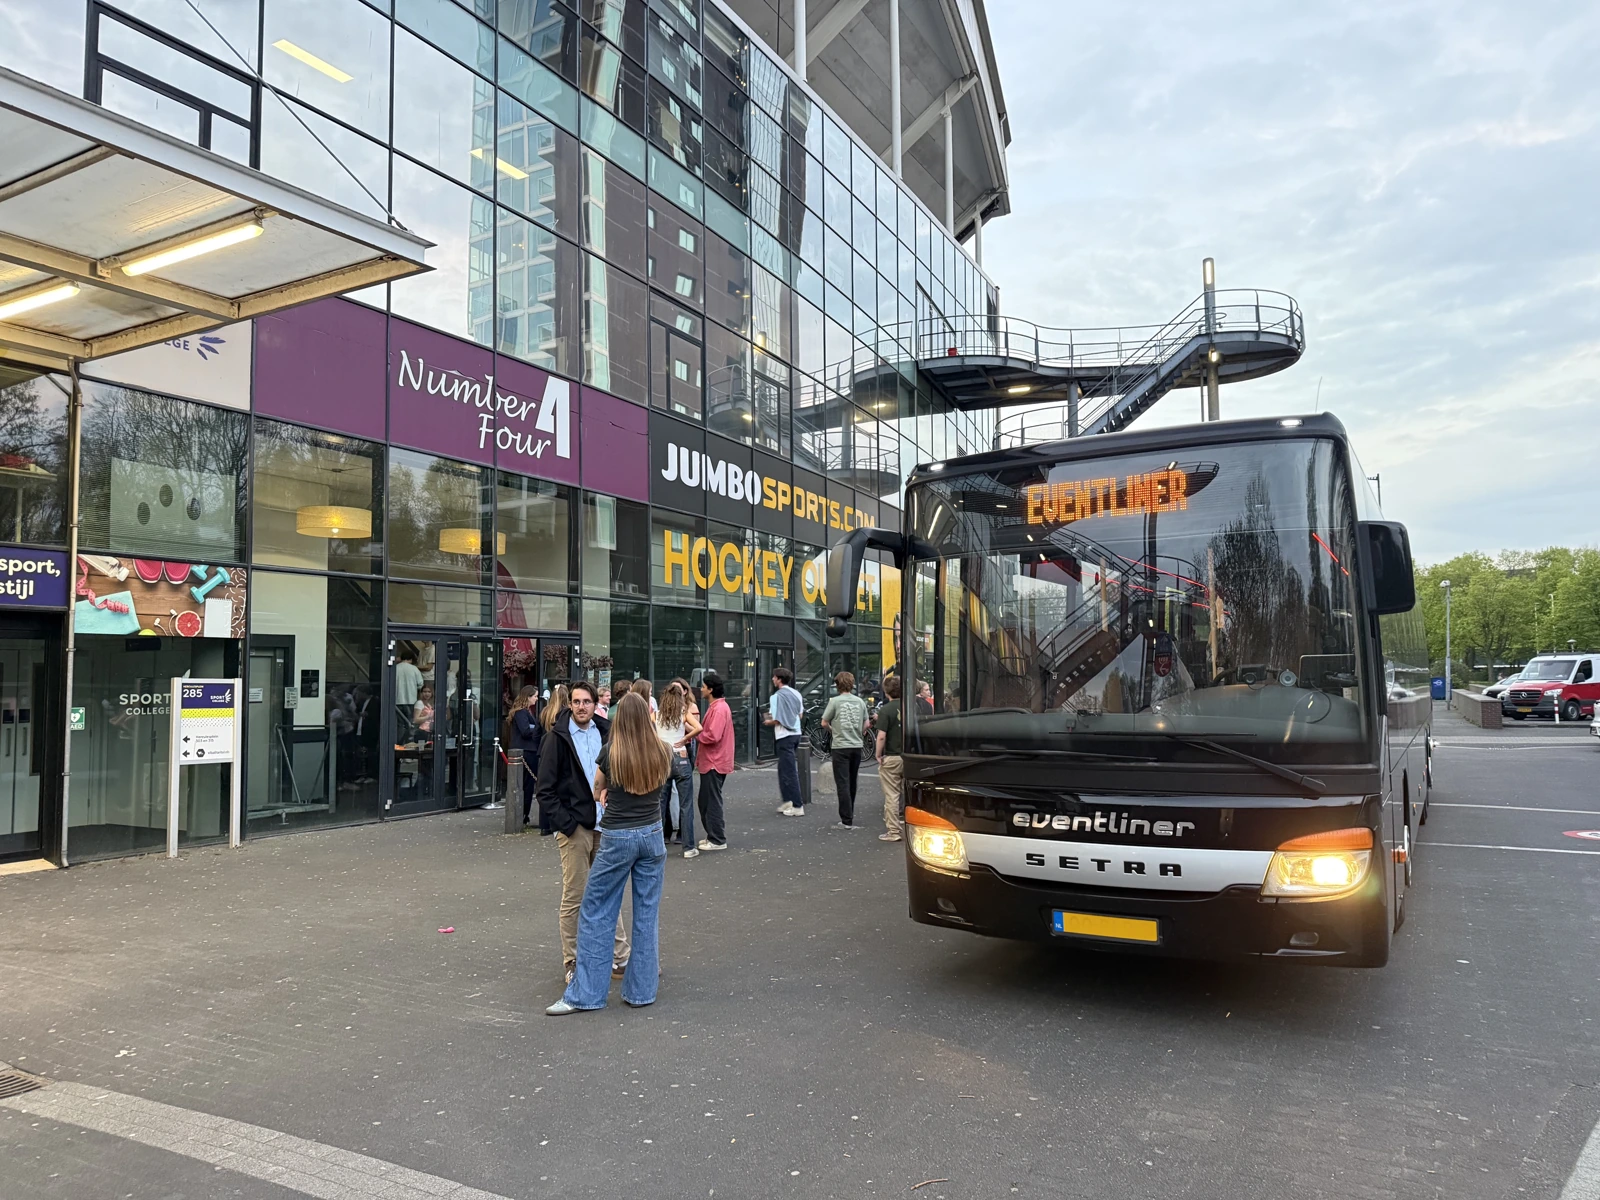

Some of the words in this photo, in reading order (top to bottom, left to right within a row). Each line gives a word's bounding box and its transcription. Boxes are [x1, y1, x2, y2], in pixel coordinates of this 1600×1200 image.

[398, 350, 536, 421] Number
[478, 413, 552, 459] Four
[1027, 469, 1187, 525] EVENTLINER
[0, 558, 61, 578] sport,
[664, 529, 794, 600] HOCKEY
[119, 693, 171, 706] SPORT
[183, 689, 203, 698] 285
[125, 706, 170, 716] COLLEGE
[1012, 811, 1196, 837] eventliner
[1025, 852, 1183, 877] SETRA
